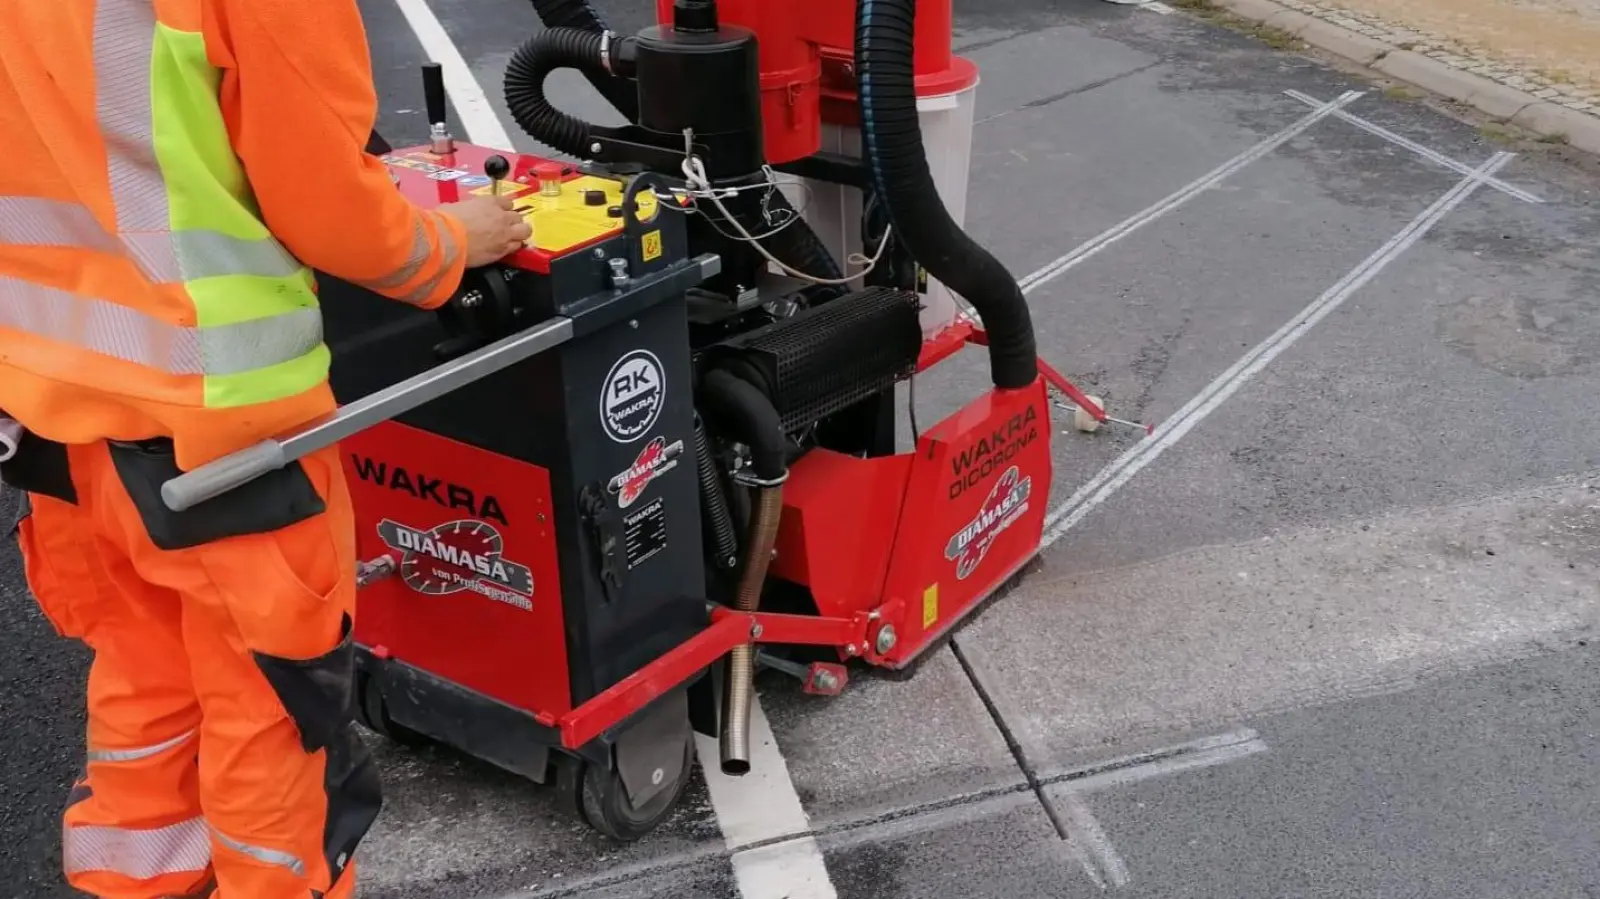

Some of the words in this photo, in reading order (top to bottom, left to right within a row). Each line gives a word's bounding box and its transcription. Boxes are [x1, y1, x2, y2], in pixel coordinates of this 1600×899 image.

[614, 365, 651, 399] RK
[613, 396, 654, 420] WAKRA
[952, 404, 1036, 475] WAKRA
[617, 454, 668, 487] DIAMASA
[949, 428, 1037, 499] DICORONA
[352, 453, 509, 526] WAKRA
[627, 502, 661, 525] WAKRA
[957, 490, 1020, 549] DIAMASA
[432, 567, 451, 580] von
